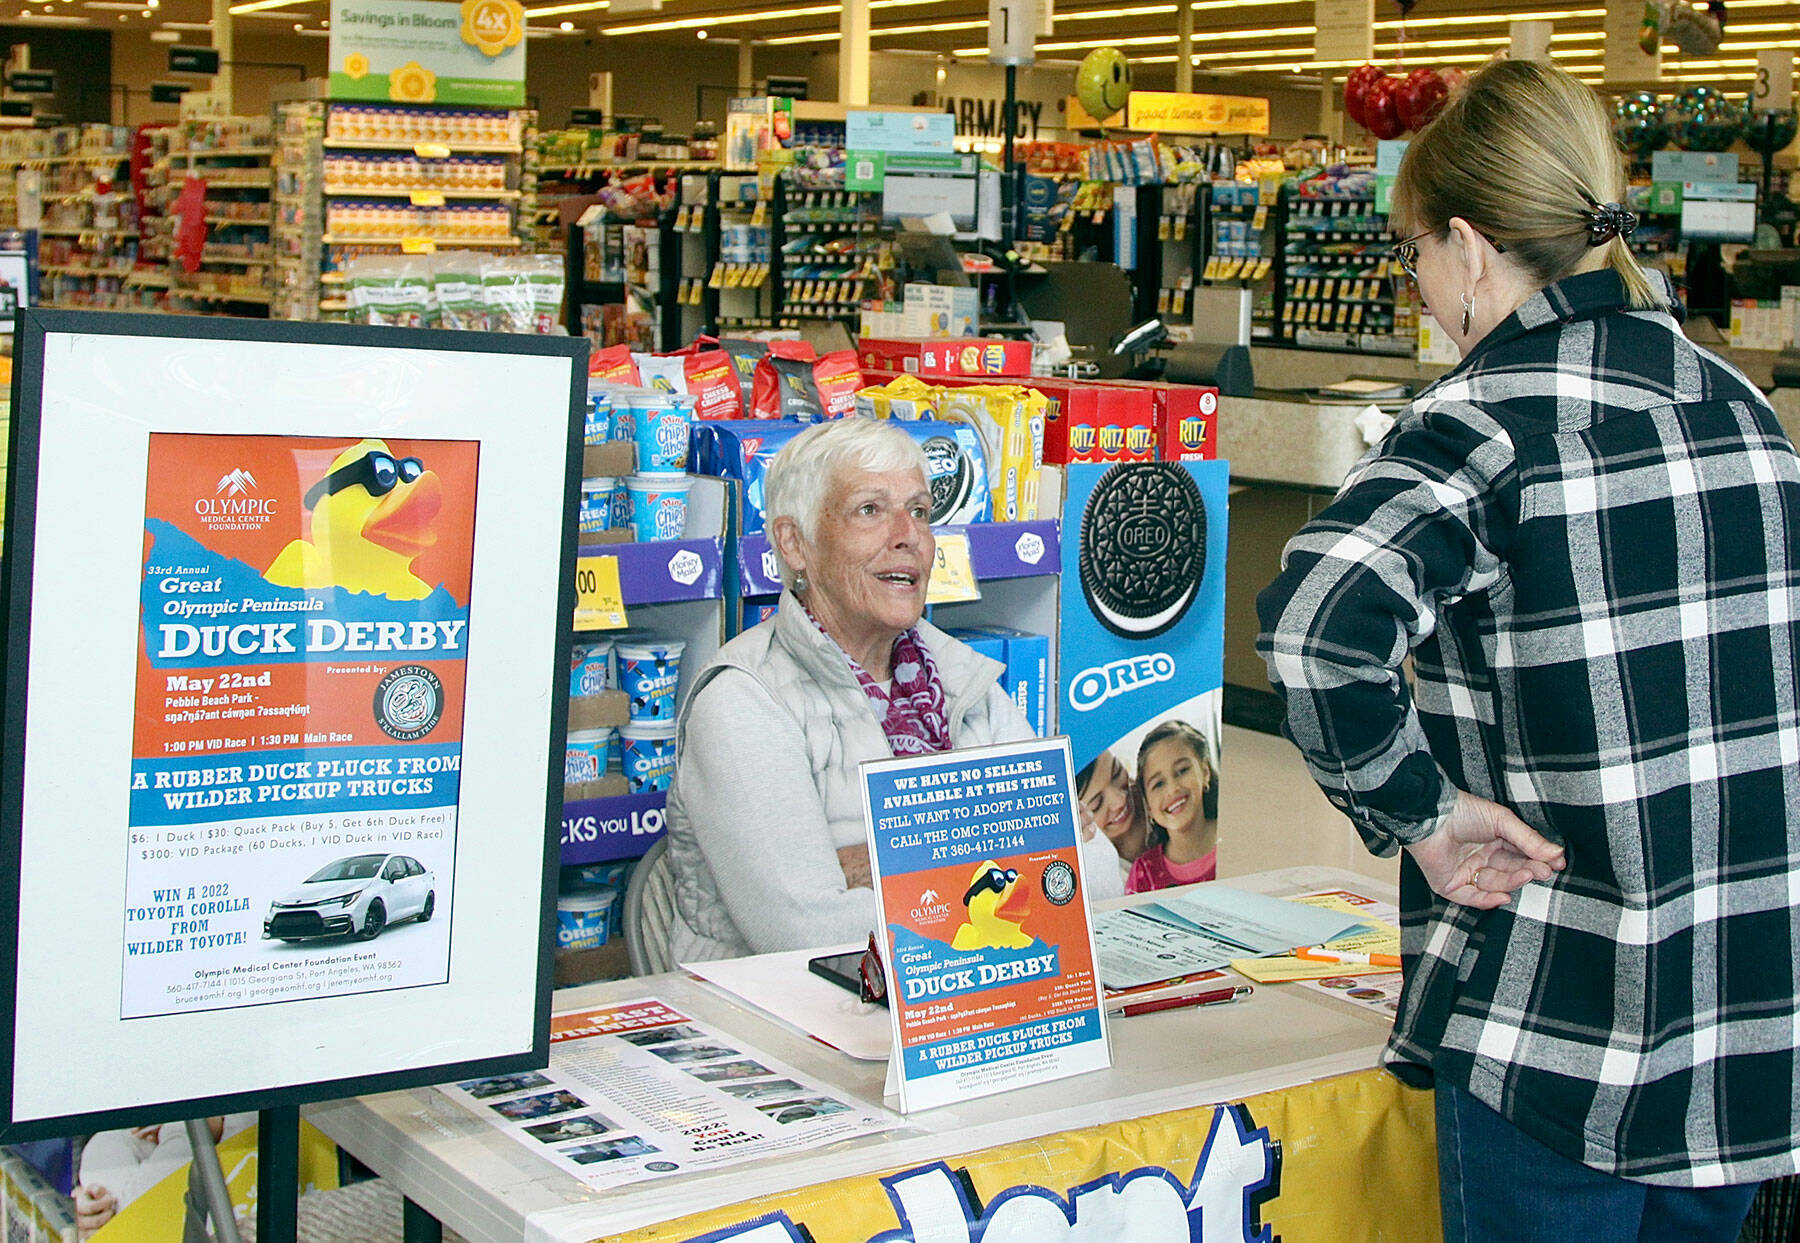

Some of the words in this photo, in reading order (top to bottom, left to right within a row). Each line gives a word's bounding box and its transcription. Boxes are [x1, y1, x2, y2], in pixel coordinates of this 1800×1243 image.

[341, 10, 394, 28] Savings
[397, 12, 410, 25] in
[412, 13, 457, 28] Bloom
[1000, 8, 1008, 44] 1
[1757, 68, 1769, 98] 3
[940, 96, 1042, 139] ARMACY
[658, 425, 685, 445] Chips
[1070, 426, 1096, 448] RITZ
[1099, 427, 1125, 448] RITZ
[1126, 428, 1151, 448] RITZ
[1179, 419, 1207, 443] RITZ
[195, 499, 277, 514] OLYMPIC
[657, 510, 682, 527] Chips
[1122, 526, 1166, 546] OREO
[148, 566, 172, 574] 33rd
[175, 565, 209, 574] Annual
[159, 577, 222, 593] Great
[163, 600, 238, 618] Olympic
[241, 598, 324, 612] Peninsula
[158, 623, 296, 658] DUCK
[306, 619, 465, 652] DERBY
[326, 666, 371, 674] Presented
[373, 666, 387, 674] by:
[380, 666, 441, 691] JAMESTOWN
[166, 676, 214, 694] May
[218, 671, 271, 689] 22nd
[1071, 655, 1174, 708] OREO
[165, 697, 200, 708] Pebble
[202, 694, 230, 706] Beach
[232, 693, 253, 704] Park
[164, 742, 185, 752] 1:00
[188, 740, 204, 751] PM
[206, 739, 222, 749] VID
[225, 737, 247, 748] Race
[261, 735, 281, 746] 1:30
[283, 734, 299, 744] PM
[304, 733, 327, 744] Main
[330, 732, 353, 742] Race
[132, 773, 148, 790] A
[154, 766, 244, 789] RUBBER
[248, 761, 312, 782] DUCK
[316, 759, 393, 778] PLUCK
[398, 755, 460, 775] FROM
[894, 778, 917, 790] WE
[921, 772, 958, 787] HAVE
[961, 768, 981, 781] NO
[984, 760, 1042, 779] SELLERS
[163, 787, 253, 810] WILDER
[257, 782, 342, 802] PICKUP
[347, 778, 433, 798] TRUCKS
[883, 788, 962, 809] AVAILABLE
[966, 785, 984, 798] AT
[987, 780, 1018, 795] THIS
[1021, 775, 1056, 790] TIME
[879, 815, 911, 830] STILL
[913, 810, 950, 824] WANT
[953, 806, 969, 819] TO
[973, 799, 1013, 817] ADOPT
[1016, 799, 1024, 810] A
[1027, 792, 1065, 807] DUCK?
[131, 834, 149, 844] $6:
[167, 830, 195, 842] Duck
[208, 827, 230, 839] $30:
[234, 825, 267, 837] Quack
[271, 822, 296, 833] Pack
[301, 821, 324, 832] (Buy
[342, 819, 362, 828] Get
[366, 818, 384, 827] 6th
[389, 816, 415, 827] Duck
[420, 814, 445, 825] Free)
[601, 818, 627, 834] YOU
[890, 833, 922, 849] CALL
[924, 830, 948, 844] THE
[951, 825, 980, 839] OMC
[983, 813, 1060, 835] FOUNDATION
[141, 850, 174, 860] $300:
[179, 848, 199, 857] VID
[203, 844, 244, 855] Package
[248, 841, 265, 851] (60
[321, 836, 341, 845] VID
[345, 833, 373, 843] Duck
[377, 833, 387, 841] in
[392, 831, 412, 840] VID
[416, 830, 443, 840] Race)
[932, 846, 947, 860] AT
[950, 835, 1025, 857] 360-417-7144
[153, 889, 181, 903] WIN
[187, 887, 196, 900] A
[201, 883, 229, 898] 2022
[127, 905, 184, 921] TOYOTA
[191, 898, 250, 916] COROLLA
[910, 903, 950, 919] OLYMPIC
[171, 920, 209, 935] FROM
[559, 926, 603, 942] OREO
[127, 940, 184, 956] WILDER
[190, 931, 247, 950] TOYOTA!
[194, 968, 230, 979] Olympic
[232, 961, 270, 974] Medical
[272, 961, 302, 970] Center
[305, 956, 352, 967] Foundation
[354, 952, 377, 961] Event
[901, 950, 932, 964] Great
[905, 959, 942, 976] Olympic
[943, 954, 984, 969] Peninsula
[230, 977, 246, 986] 1015
[249, 972, 293, 985] Georgiana
[310, 969, 325, 978] Port
[327, 966, 361, 977] Angeles,
[362, 963, 375, 971] WA
[377, 961, 402, 970] 98362
[905, 969, 976, 999] DUCK
[979, 954, 1055, 984] DERBY
[588, 1006, 664, 1024] PAST
[905, 1008, 927, 1020] May
[928, 1002, 954, 1016] 22nd
[920, 1049, 928, 1060] A
[929, 1040, 976, 1059] RUBBER
[977, 1031, 1010, 1048] DUCK
[1012, 1023, 1050, 1041] PLUCK
[1052, 1016, 1086, 1033] FROM
[935, 1053, 983, 1070] WILDER
[984, 1042, 1027, 1060] PICKUP
[1028, 1031, 1073, 1050] TRUCKS
[692, 1144, 715, 1152] Be
[719, 1134, 765, 1150] Next!
[694, 1129, 730, 1138] You
[694, 1131, 747, 1145] Could
